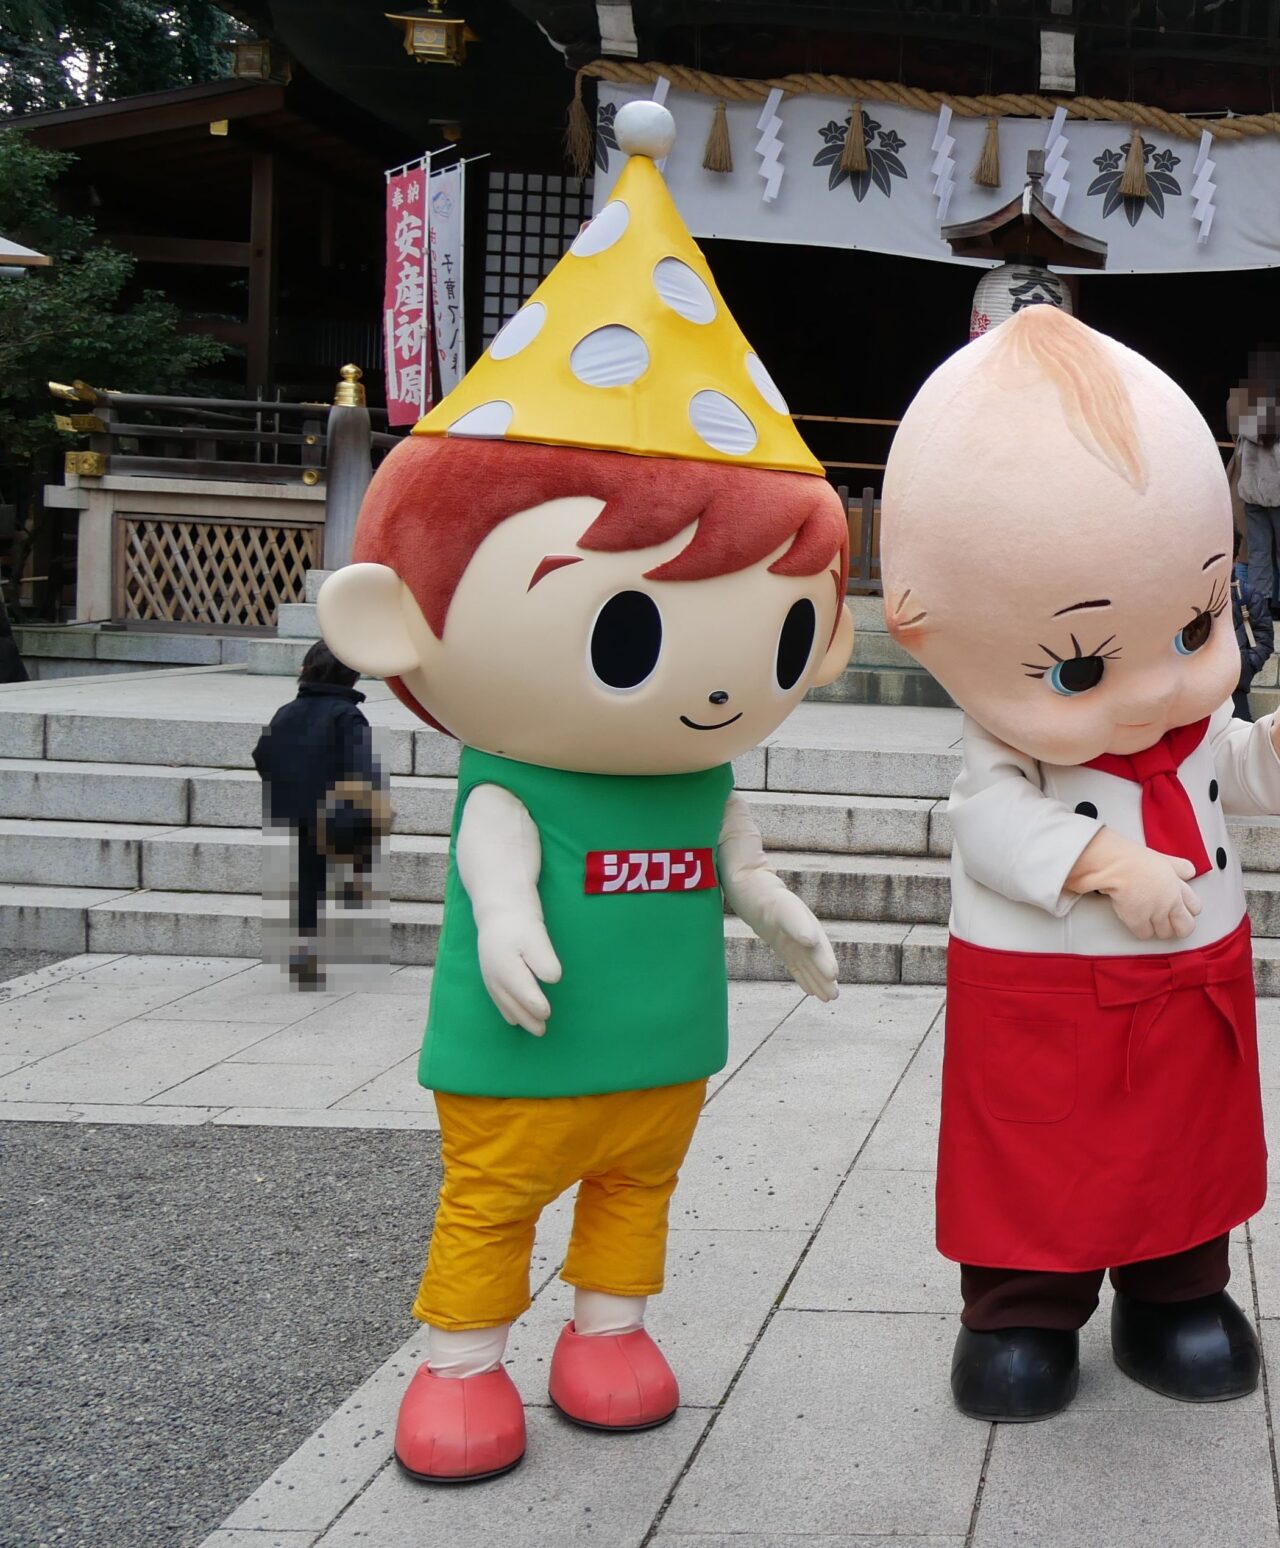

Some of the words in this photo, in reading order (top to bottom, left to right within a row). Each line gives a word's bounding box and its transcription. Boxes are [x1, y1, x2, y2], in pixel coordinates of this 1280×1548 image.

[602, 851, 702, 892] シスコーン
